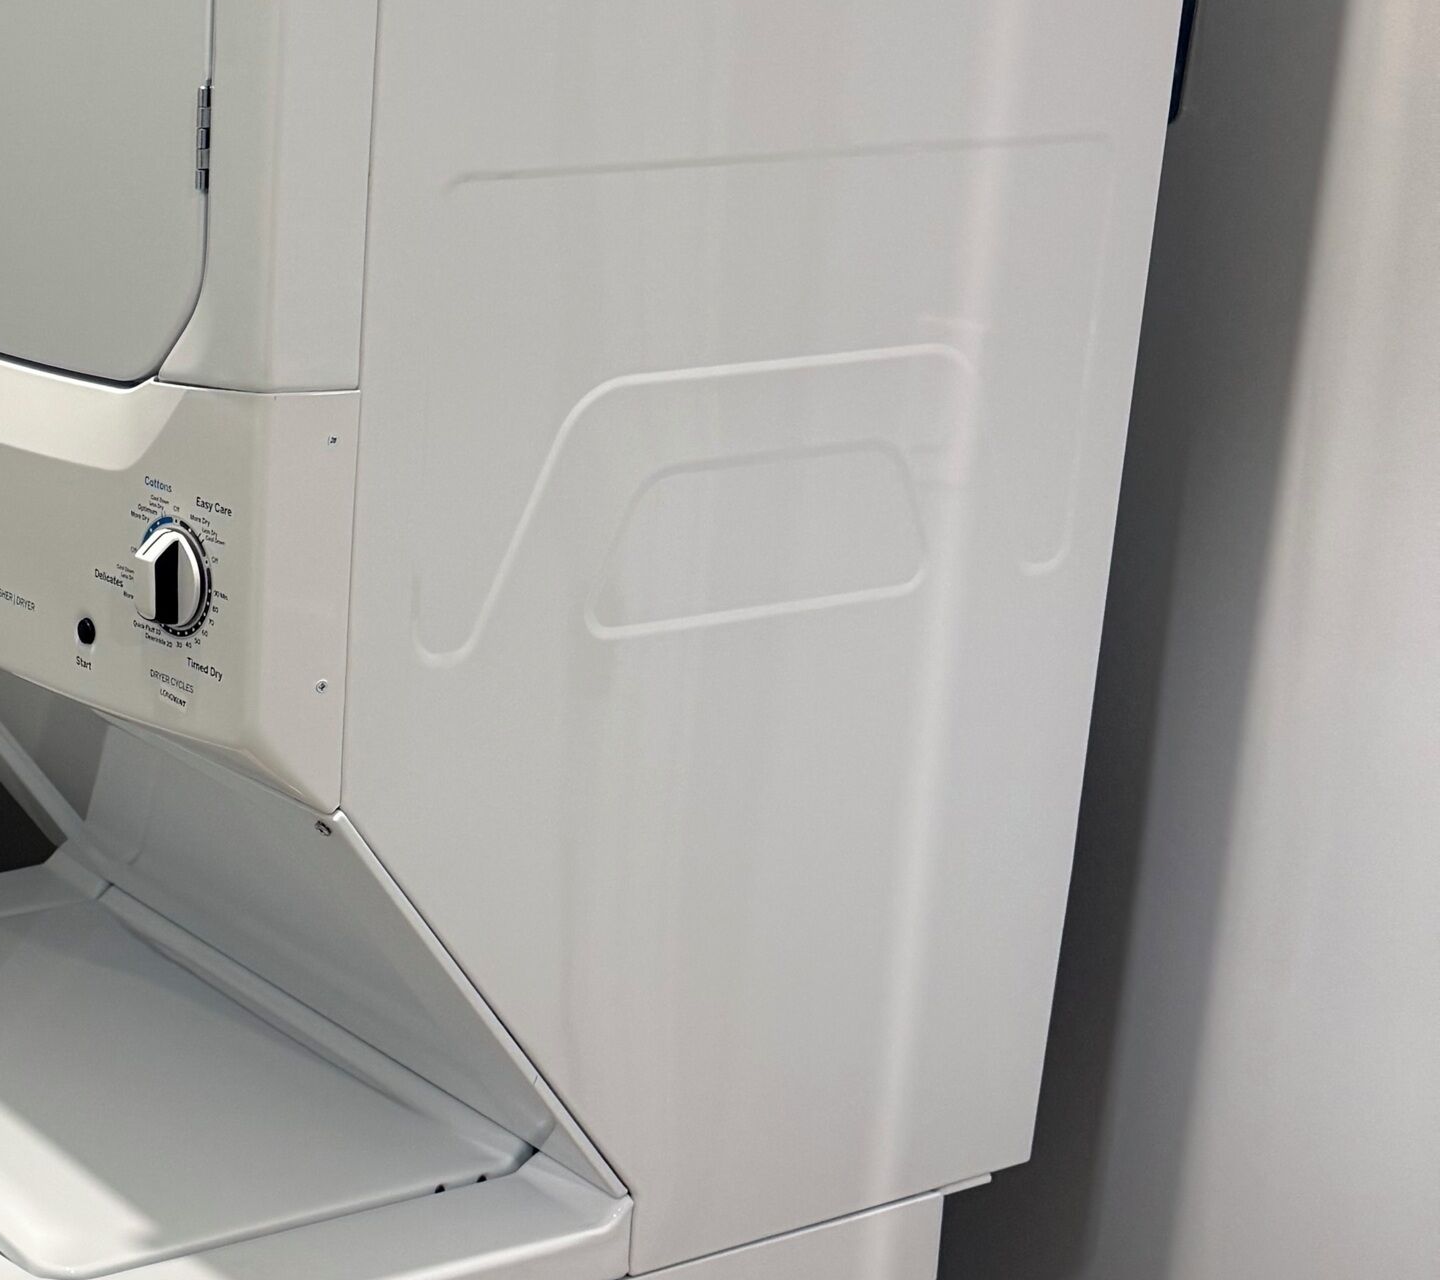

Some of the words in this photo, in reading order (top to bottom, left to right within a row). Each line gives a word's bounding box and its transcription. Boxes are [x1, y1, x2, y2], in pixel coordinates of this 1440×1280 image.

[144, 476, 172, 492] Cottons
[196, 496, 213, 512] Easy
[214, 502, 232, 517] Care
[94, 568, 124, 588] Delicates
[76, 656, 92, 670] Start
[186, 656, 208, 674] Timed
[210, 666, 223, 682] Dry
[170, 677, 194, 693] CYCLES
